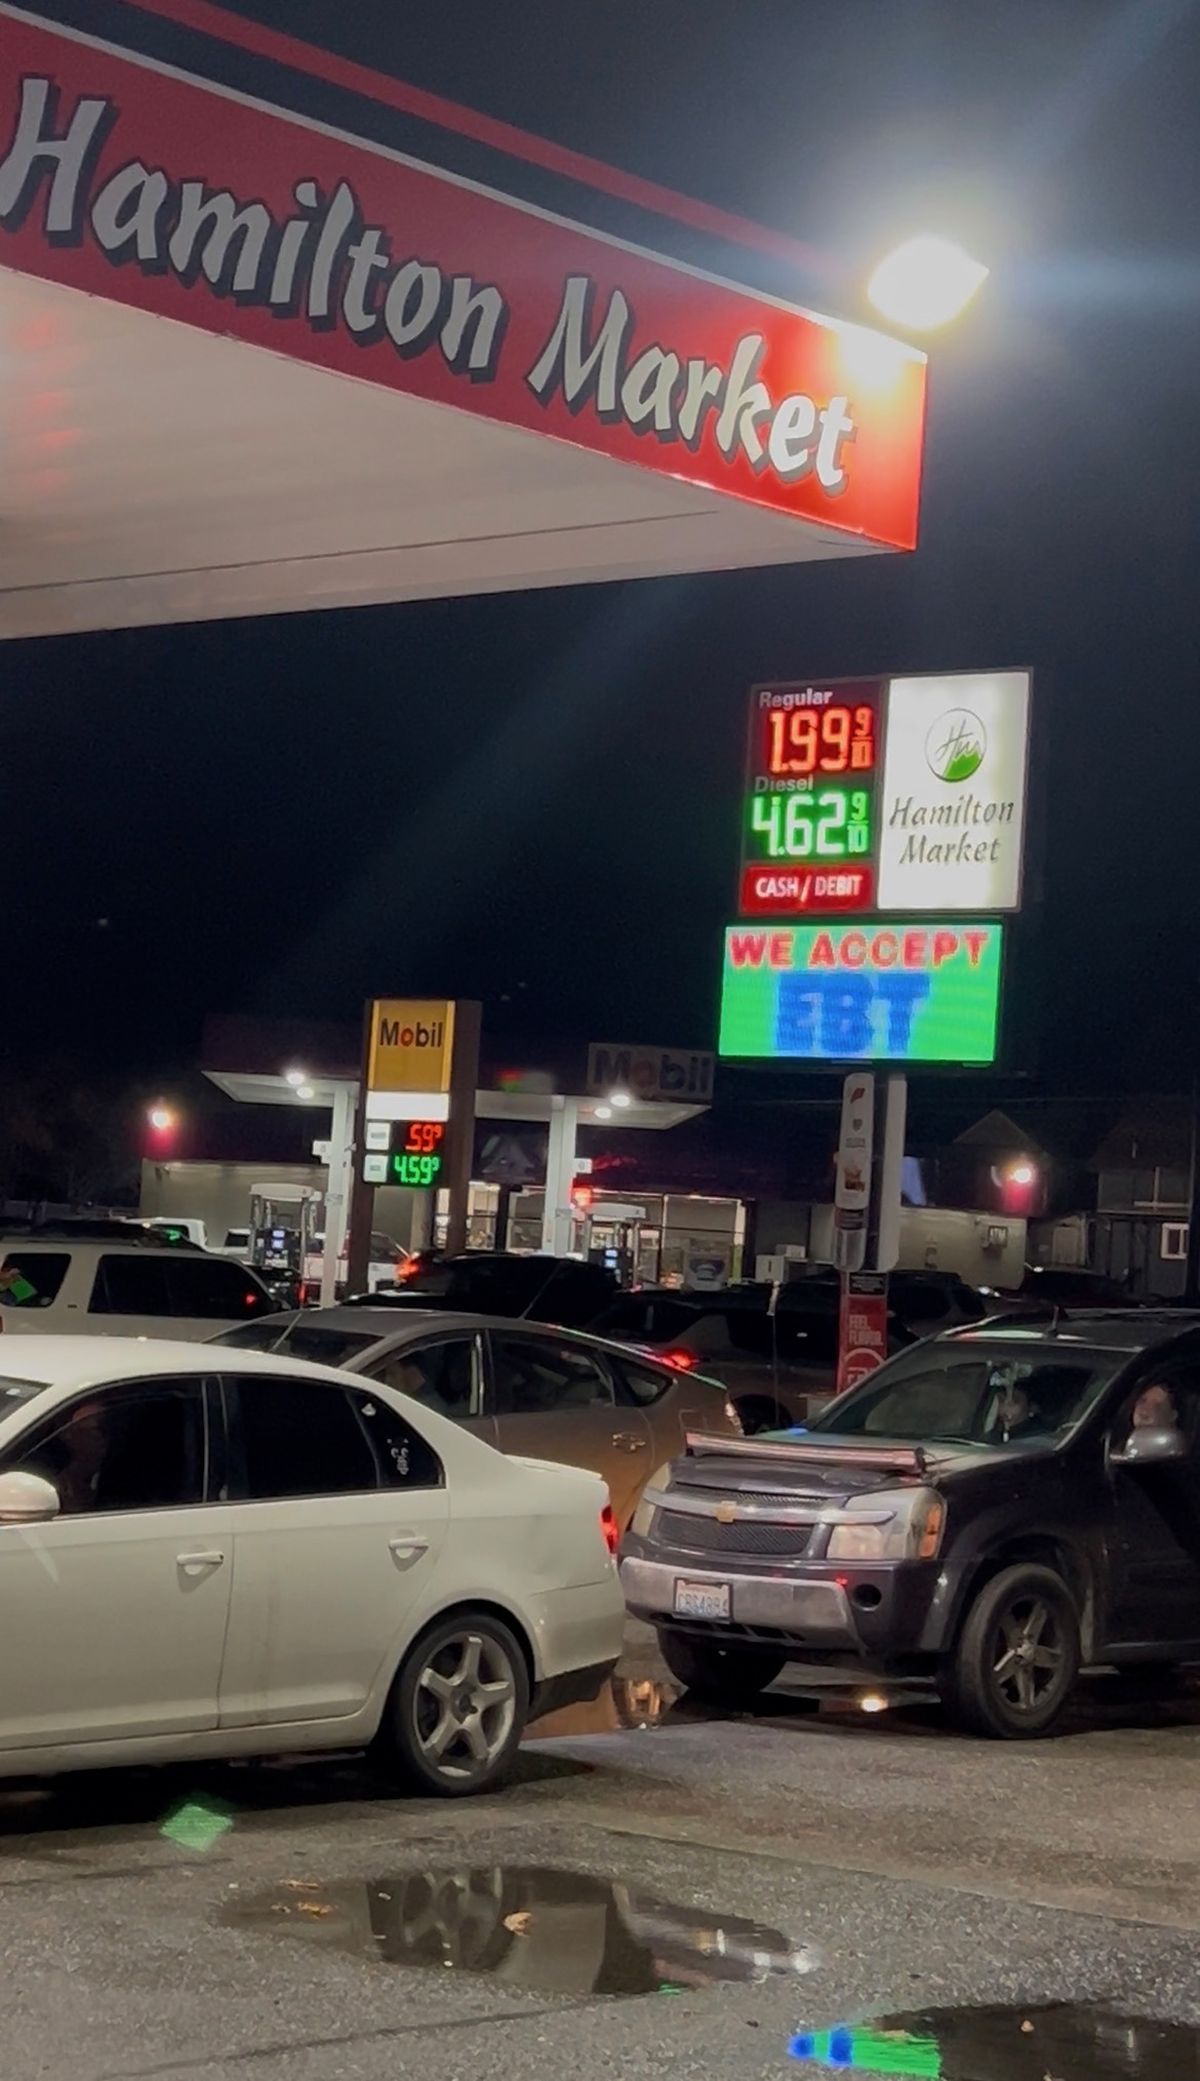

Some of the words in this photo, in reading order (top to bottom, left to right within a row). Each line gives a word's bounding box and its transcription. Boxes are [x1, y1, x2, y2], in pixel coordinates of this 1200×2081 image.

[0, 78, 505, 376] Hamilton
[528, 276, 855, 494] Market
[759, 688, 834, 707] Regular
[755, 776, 813, 792] Diesel
[888, 795, 1015, 828] Hamilton
[899, 831, 1001, 865] Market
[755, 875, 799, 898] CASH
[814, 874, 863, 897] DEBIT
[729, 931, 795, 969] WE
[807, 930, 990, 968] ACCEPT
[773, 970, 932, 1054] EBT
[379, 1018, 443, 1048] Mobil
[593, 1049, 712, 1092] Mobil
